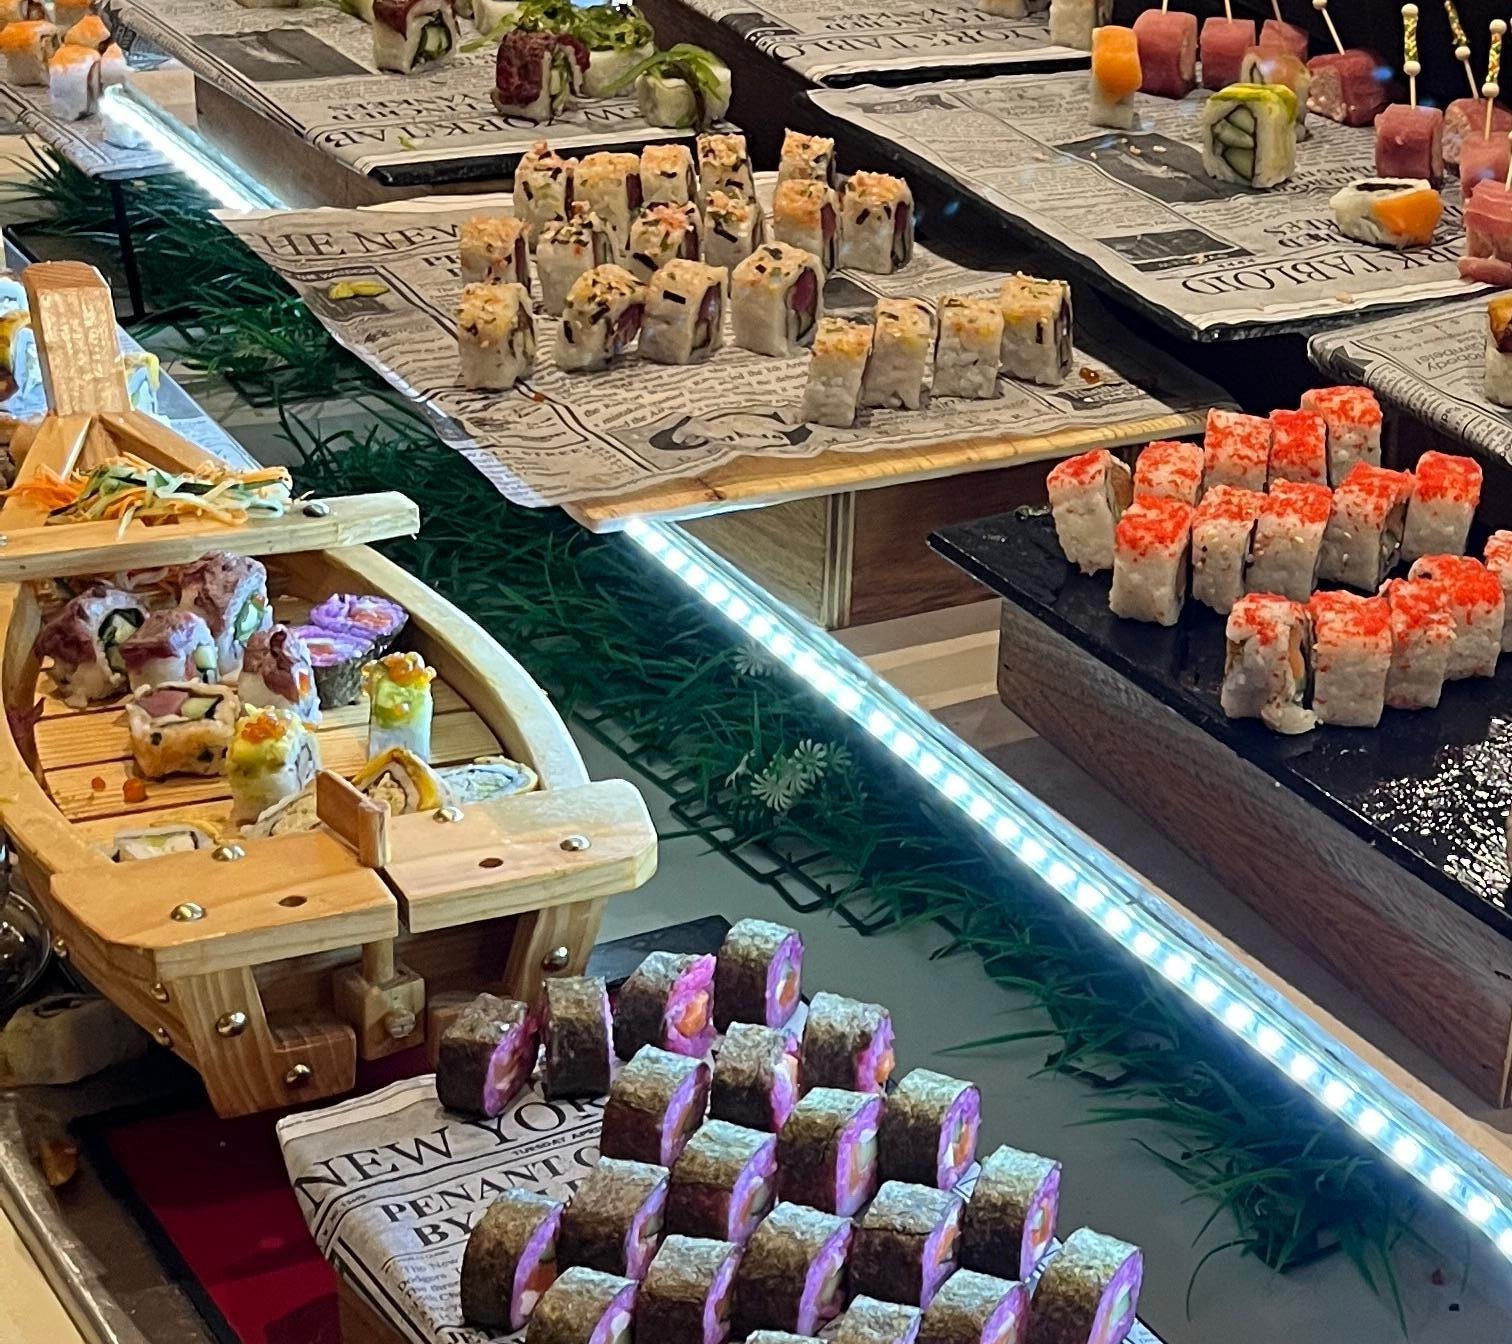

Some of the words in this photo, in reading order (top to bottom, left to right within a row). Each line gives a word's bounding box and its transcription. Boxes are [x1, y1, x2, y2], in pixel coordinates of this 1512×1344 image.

[770, 31, 917, 60] TABLO
[1180, 244, 1390, 307] TABLOID
[294, 1125, 453, 1216] NEW
[378, 1154, 562, 1223] PENANT
[412, 1212, 475, 1248] BY
